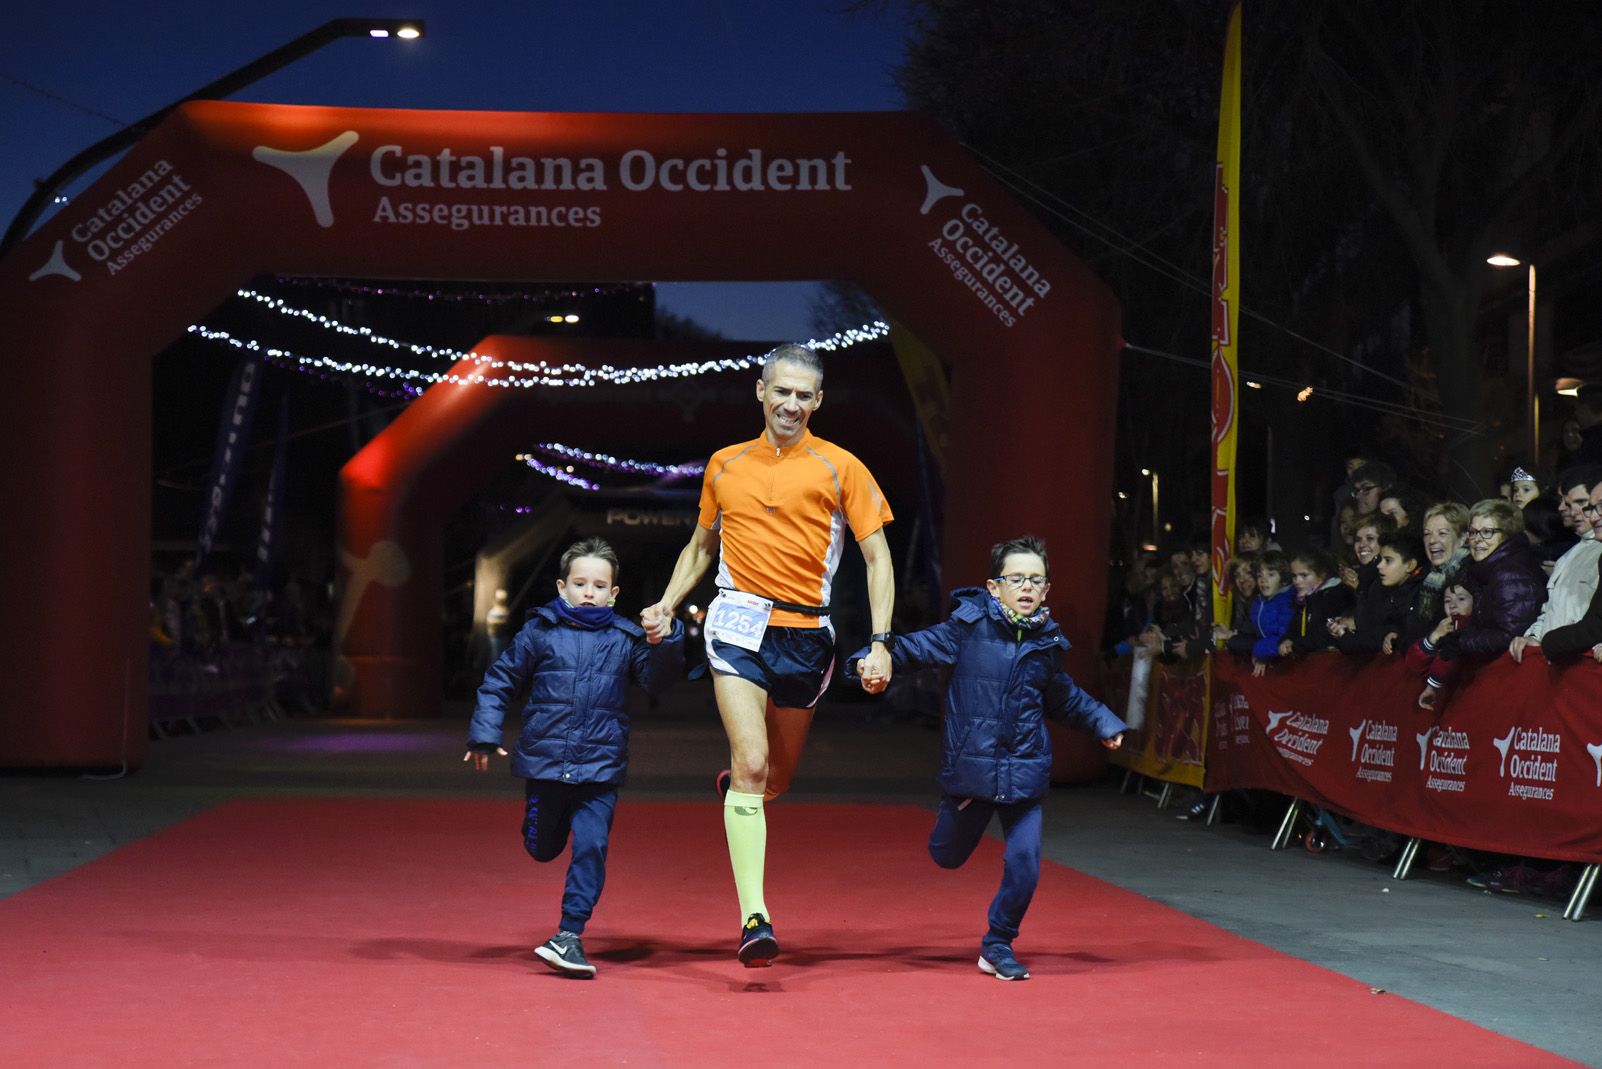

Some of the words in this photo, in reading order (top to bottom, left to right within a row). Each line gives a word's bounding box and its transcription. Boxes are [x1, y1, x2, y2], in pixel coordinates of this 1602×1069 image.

[369, 144, 608, 191] Catalana
[619, 147, 852, 192] Occident
[71, 159, 174, 242] Catalana
[87, 174, 192, 260] Occident
[372, 195, 602, 231] Assegurances
[106, 192, 203, 276] Assegurances
[961, 203, 1052, 299] Catalana
[927, 238, 1017, 328] Assegurances
[942, 218, 1035, 317] Occident
[711, 608, 764, 638] 1254
[1365, 719, 1398, 742] Catalana
[1513, 726, 1561, 754] Catalana
[1360, 743, 1395, 767] Occident
[1430, 750, 1468, 776] Occident
[1510, 754, 1558, 783] Occident
